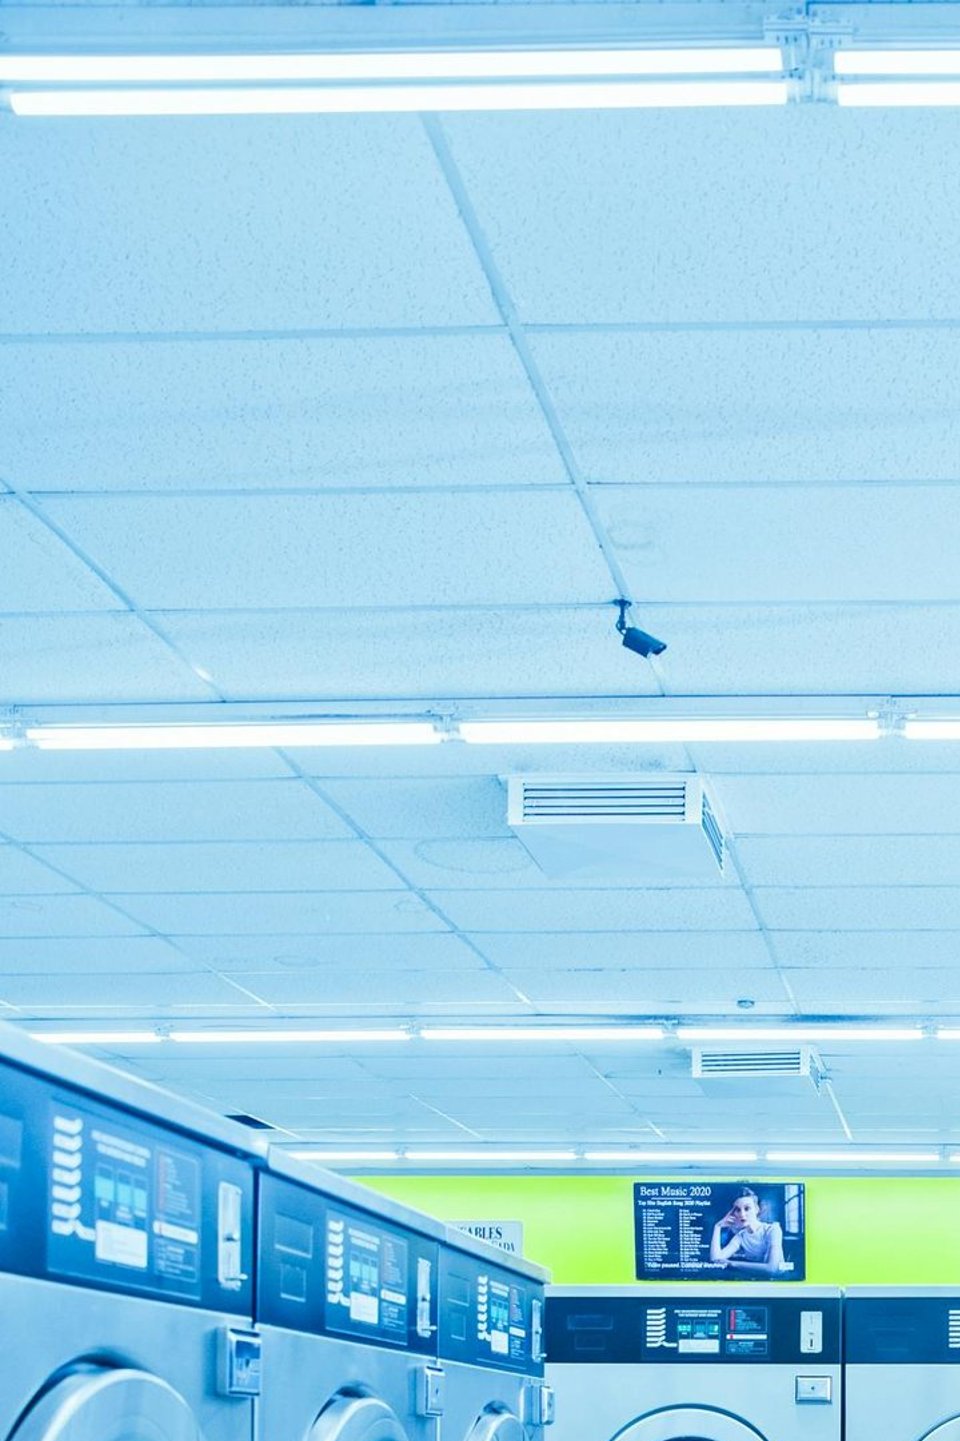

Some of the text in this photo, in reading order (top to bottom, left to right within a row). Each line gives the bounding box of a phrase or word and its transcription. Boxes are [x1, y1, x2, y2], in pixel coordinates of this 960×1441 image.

[639, 1186, 712, 1196] Best Music 2020
